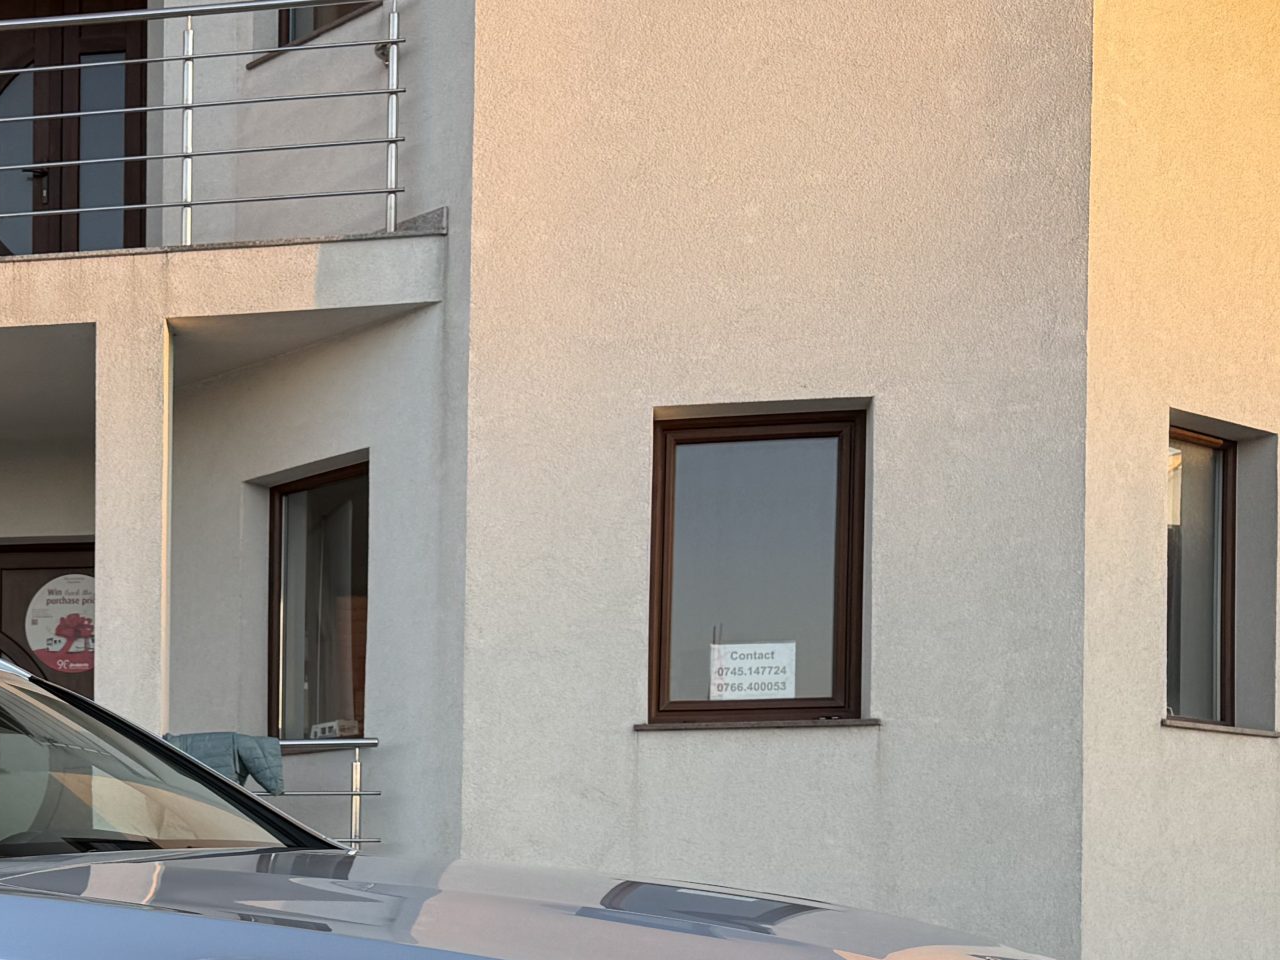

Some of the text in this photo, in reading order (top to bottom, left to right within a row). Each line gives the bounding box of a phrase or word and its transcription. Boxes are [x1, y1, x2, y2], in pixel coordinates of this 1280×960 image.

[46, 597, 80, 606] purchase
[730, 651, 775, 661] Contact
[717, 666, 787, 677] 0745.147724
[717, 682, 787, 692] 0766.400053
